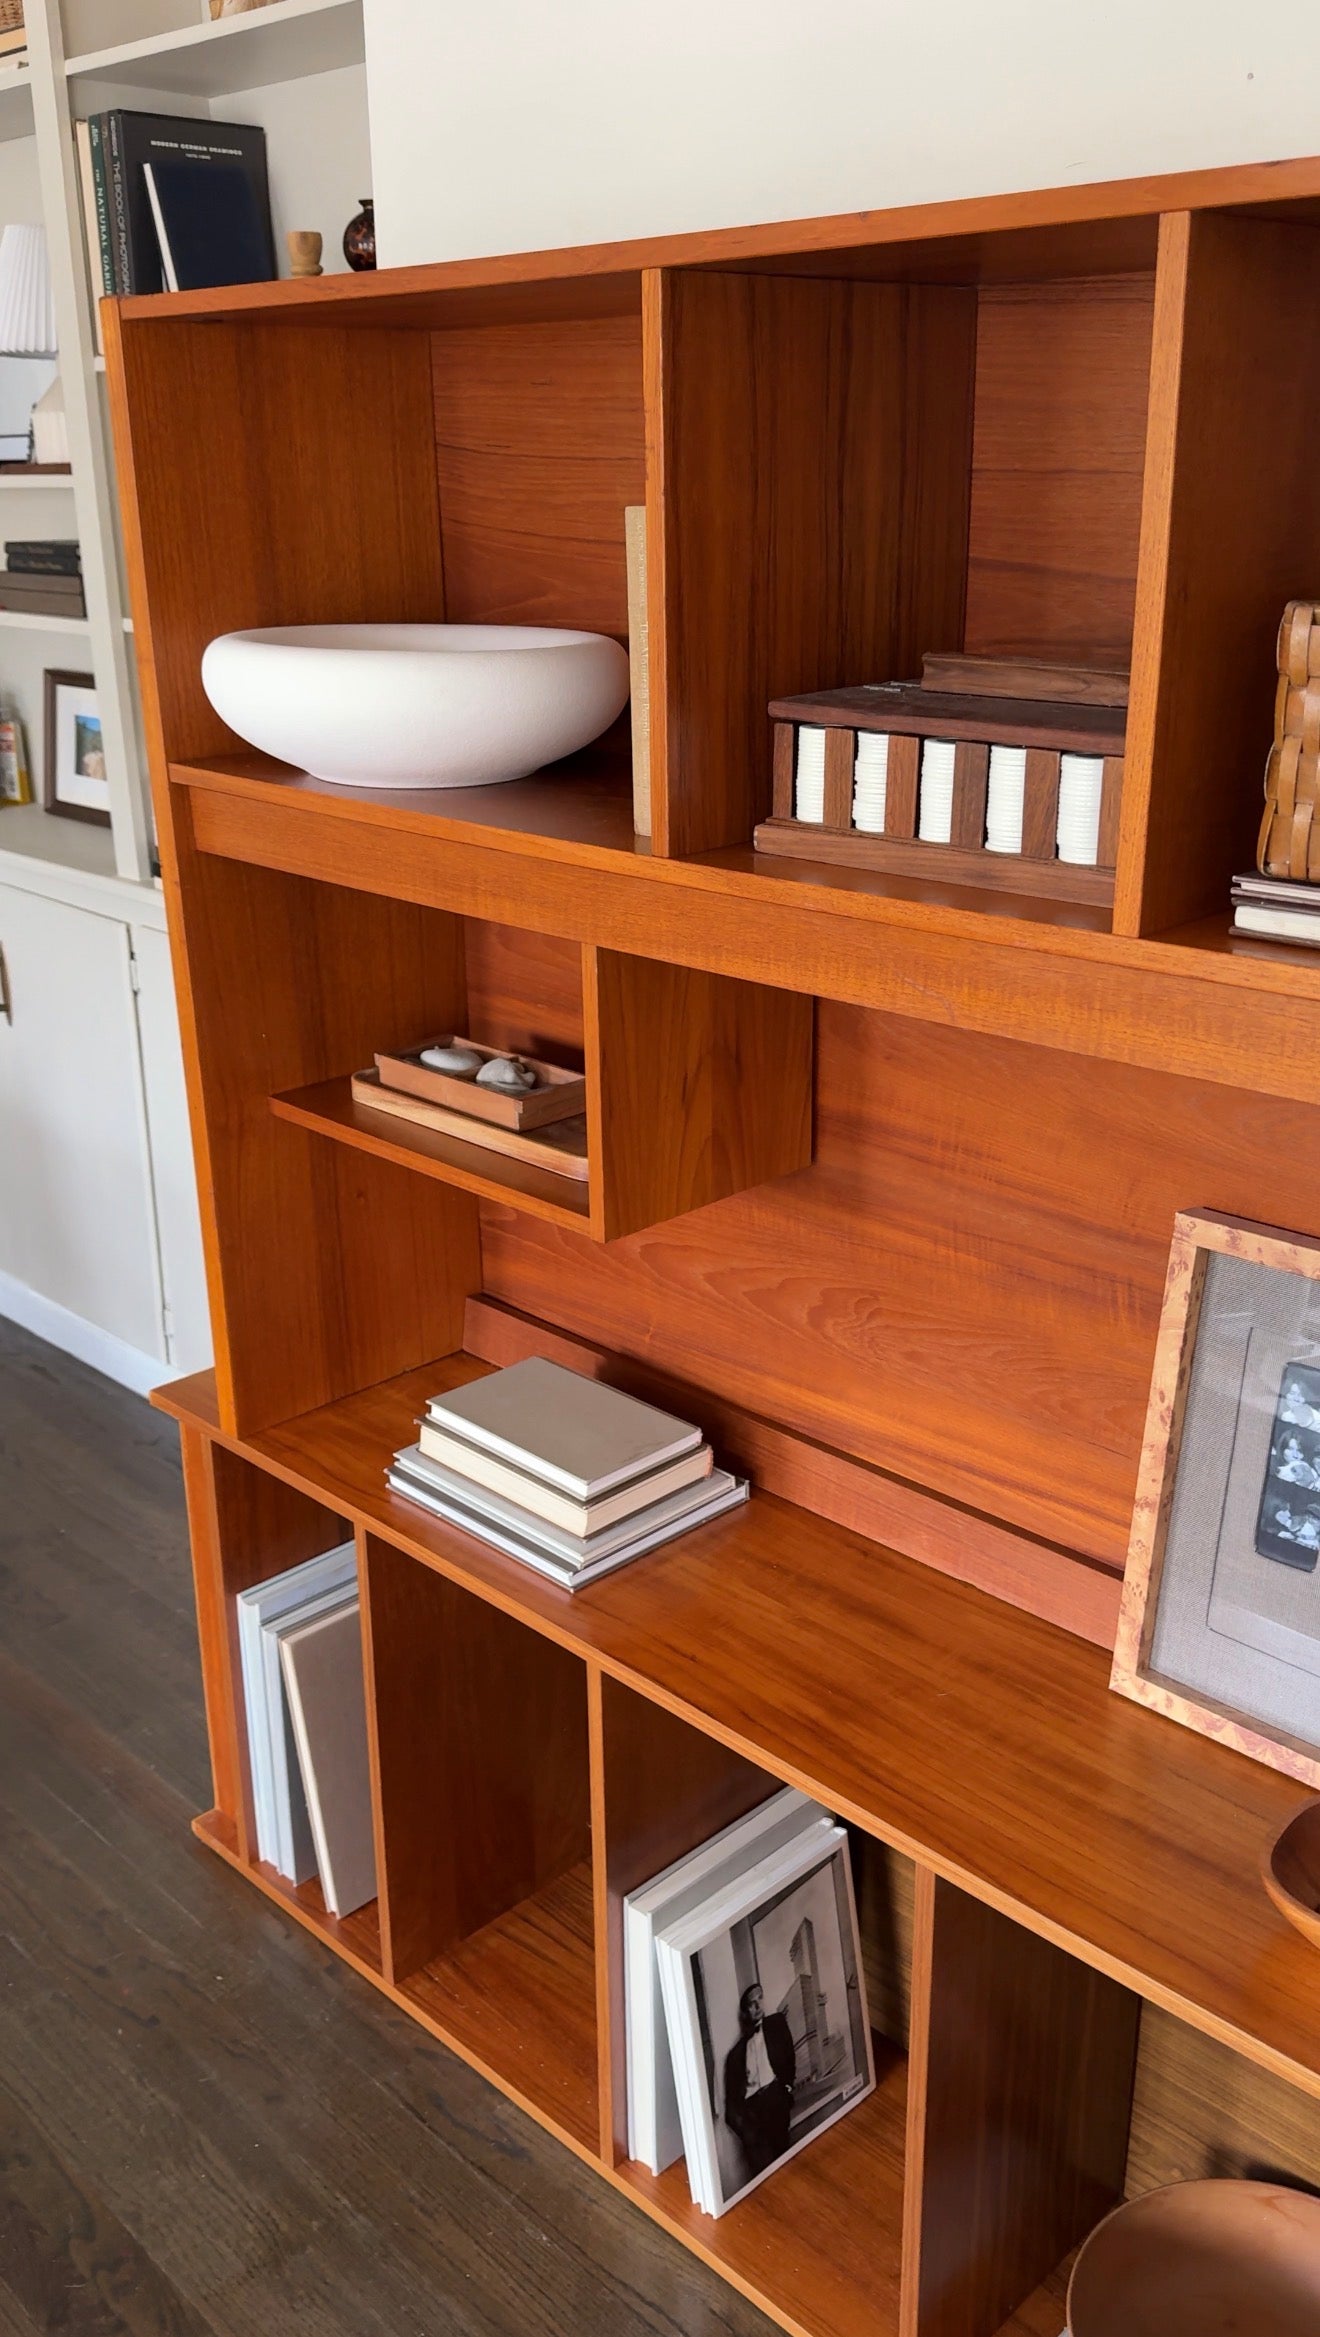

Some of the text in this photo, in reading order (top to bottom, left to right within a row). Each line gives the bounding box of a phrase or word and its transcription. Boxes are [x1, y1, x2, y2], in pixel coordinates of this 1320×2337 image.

[150, 140, 243, 156] MODERN GERMAN DRAWINGS
[113, 160, 121, 183] THE
[114, 183, 124, 215] BOOK
[97, 187, 108, 249] NATURAL
[117, 215, 126, 231] OF
